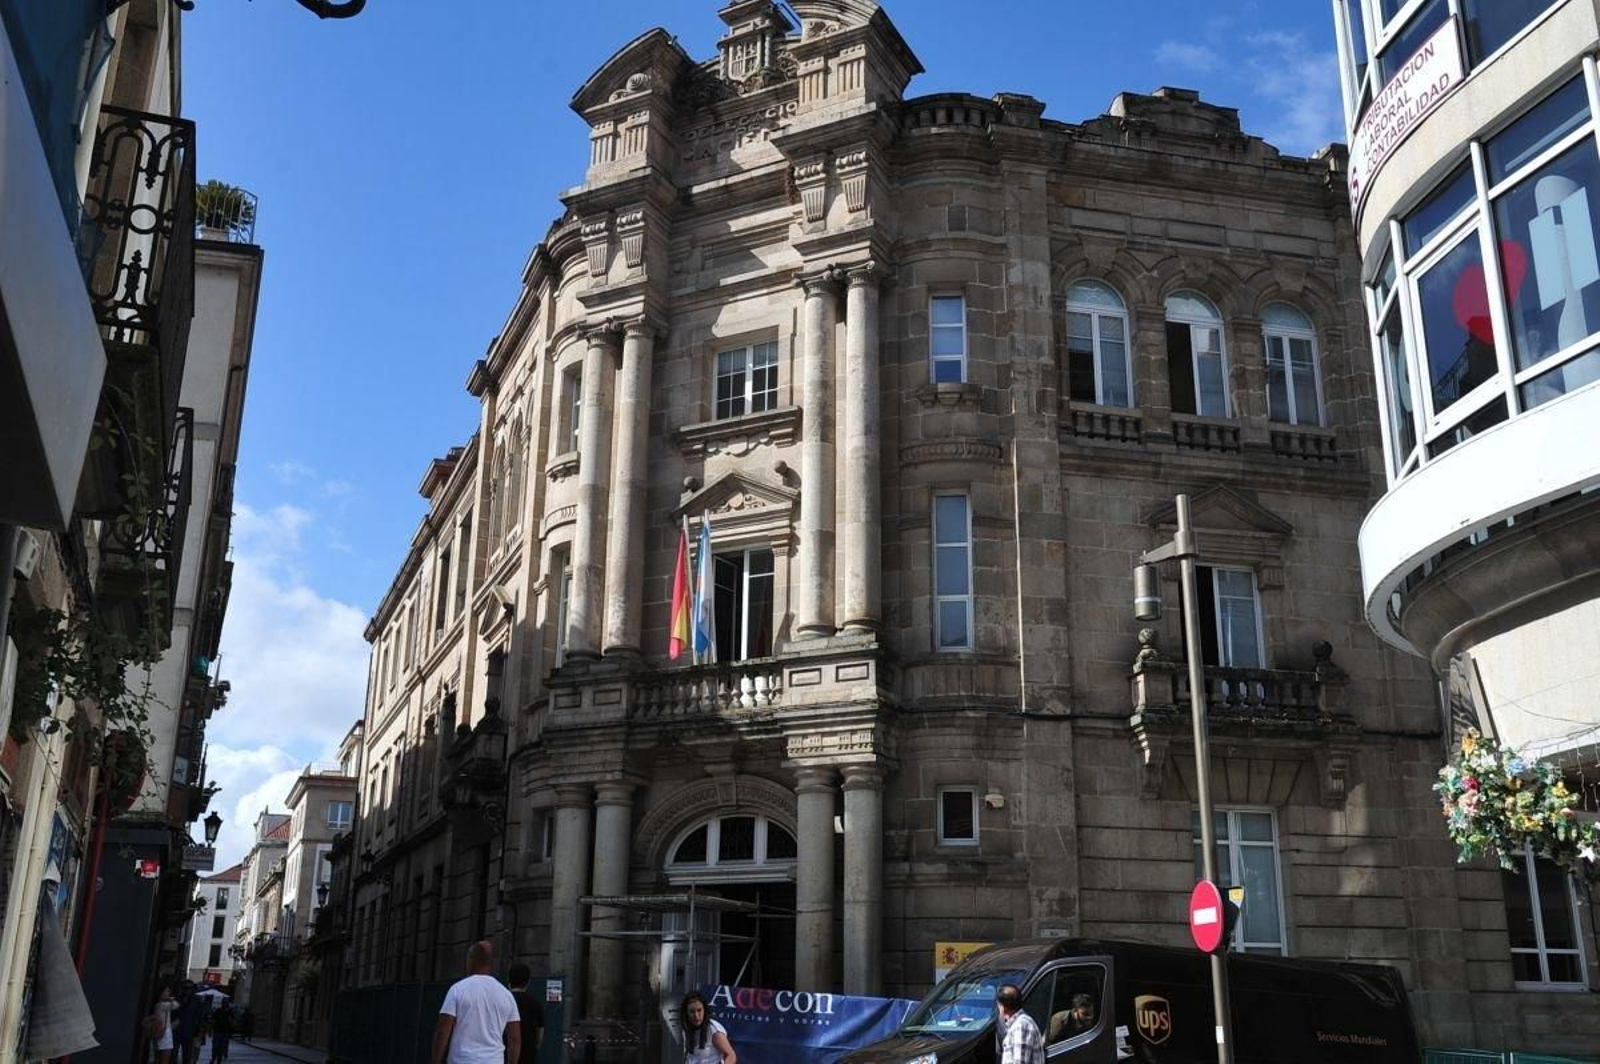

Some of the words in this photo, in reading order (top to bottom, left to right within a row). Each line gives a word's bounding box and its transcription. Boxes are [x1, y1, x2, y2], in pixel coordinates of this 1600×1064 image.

[1363, 41, 1435, 136] TRIBUTACION
[1365, 90, 1412, 155] LABORAL
[1368, 73, 1450, 172] CONTABILIDAD
[708, 985, 834, 1014] Adecon
[1139, 1009, 1169, 1036] ups
[1316, 1031, 1349, 1043] Servicios
